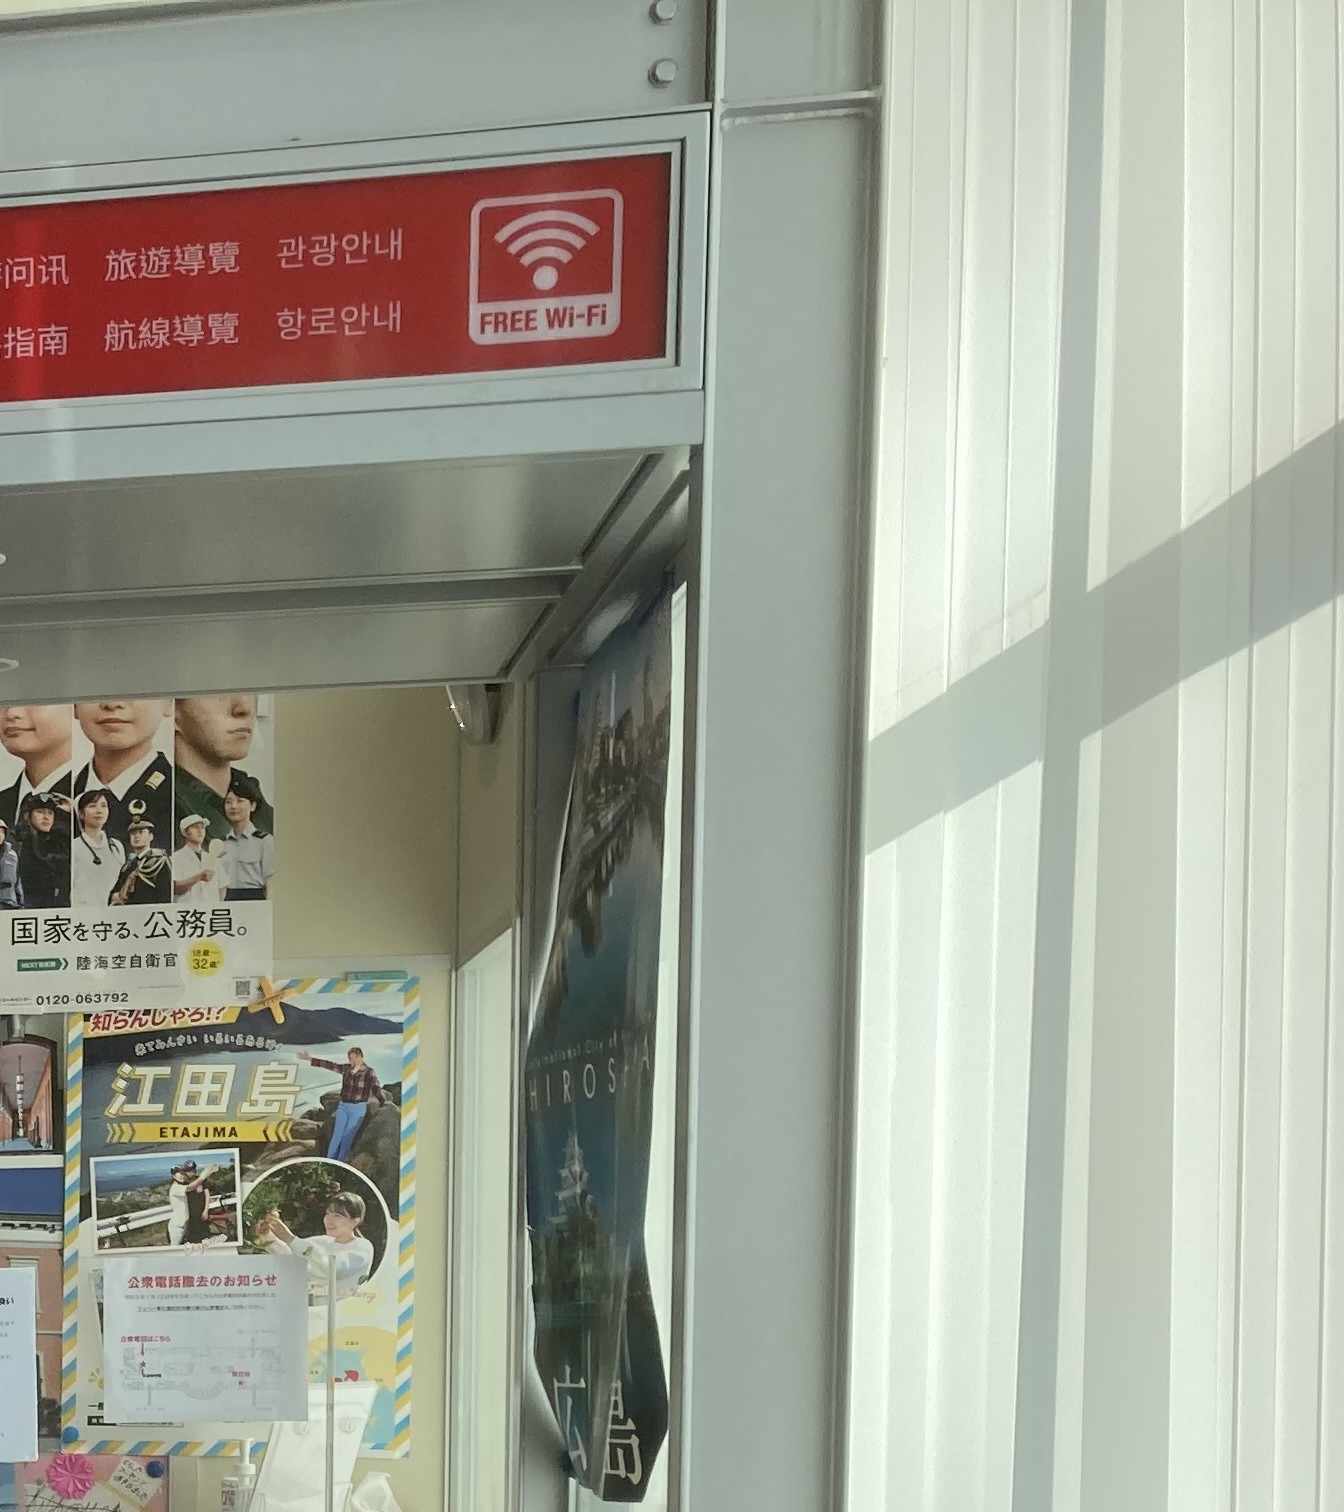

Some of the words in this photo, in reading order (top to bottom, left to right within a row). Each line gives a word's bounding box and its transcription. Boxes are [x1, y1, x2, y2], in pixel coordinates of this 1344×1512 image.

[105, 241, 240, 283] 旅遊導覽
[276, 228, 403, 270] 관광안내
[105, 313, 240, 353] 航線導覽
[276, 301, 402, 341] 항로안내
[479, 307, 541, 335] FREE
[546, 304, 609, 331] Wi-Fi
[11, 908, 249, 946] 国家を守る、公務員。
[76, 951, 179, 971] 陸海空自衛官
[36, 991, 129, 1006] 0120-063792
[106, 1061, 303, 1118] 江田島
[158, 1125, 239, 1139] ETAJIMA
